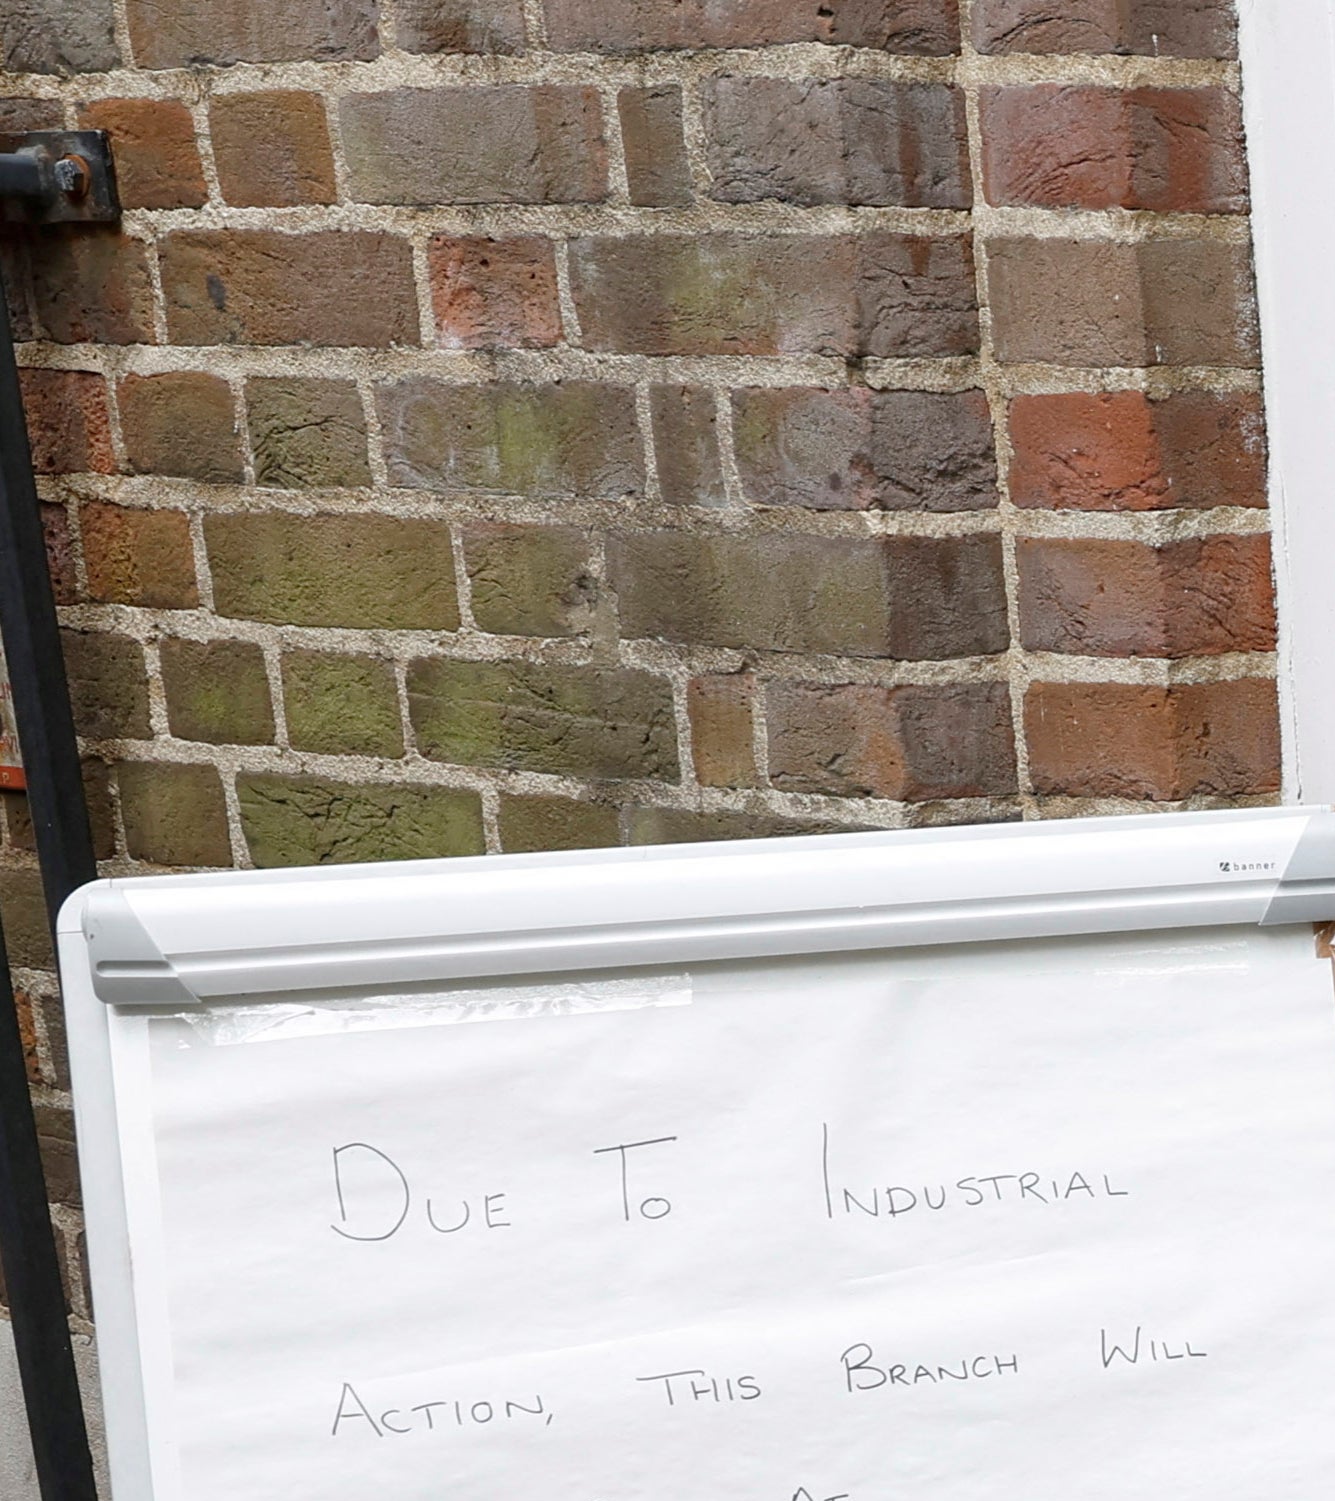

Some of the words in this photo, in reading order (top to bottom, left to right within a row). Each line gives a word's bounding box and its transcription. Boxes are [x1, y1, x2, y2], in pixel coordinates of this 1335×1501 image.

[1233, 862, 1276, 871] banner
[331, 1141, 512, 1242] DUE
[594, 1136, 678, 1222] TO
[822, 1122, 1130, 1218] INDUSTRIAL
[331, 1382, 554, 1437] ACTION,
[637, 1368, 763, 1405] THIS
[841, 1342, 1019, 1393] BRANCH
[1099, 1325, 1209, 1370] WILL
